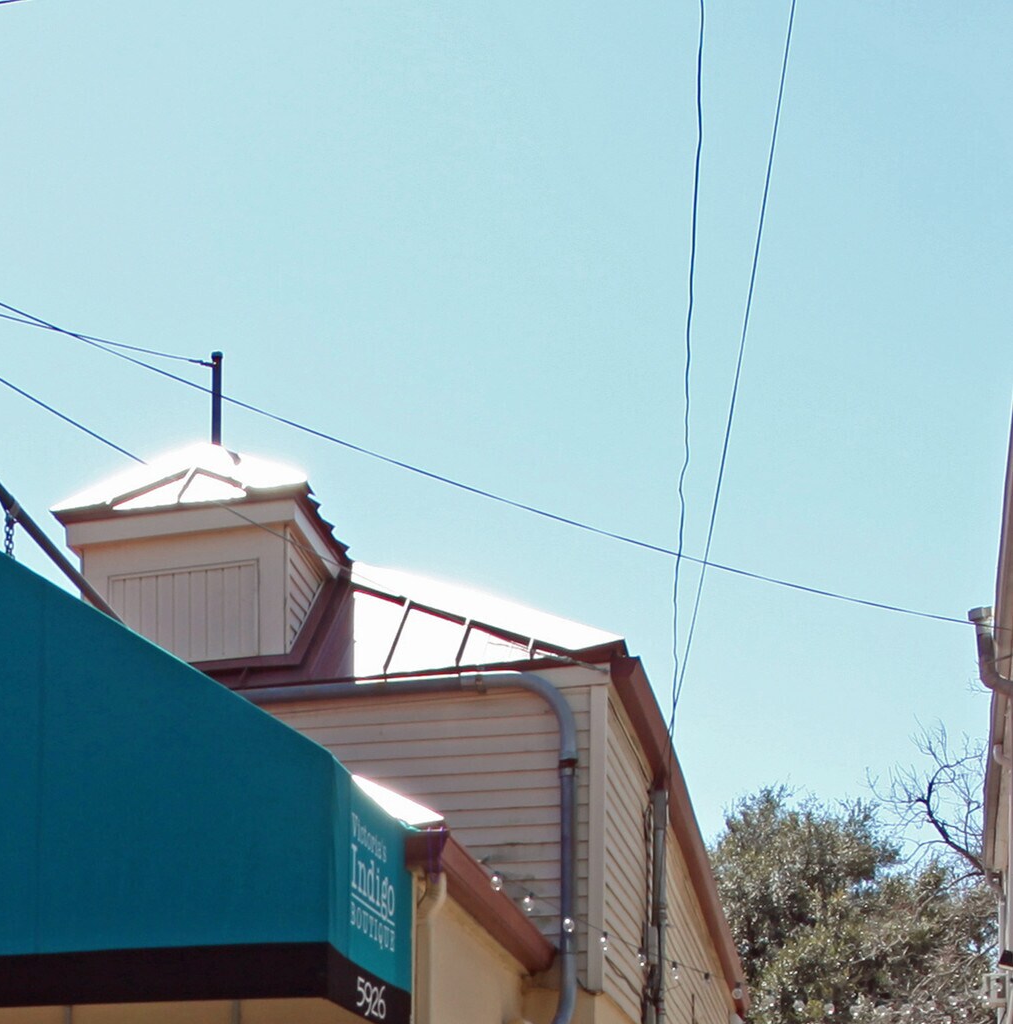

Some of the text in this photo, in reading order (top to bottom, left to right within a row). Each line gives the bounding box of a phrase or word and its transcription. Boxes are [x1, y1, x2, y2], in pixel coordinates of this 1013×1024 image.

[351, 812, 387, 864] Victoria's
[351, 843, 395, 922] Indigo
[350, 901, 395, 953] BOUTIQUE
[356, 975, 387, 1020] 5926
